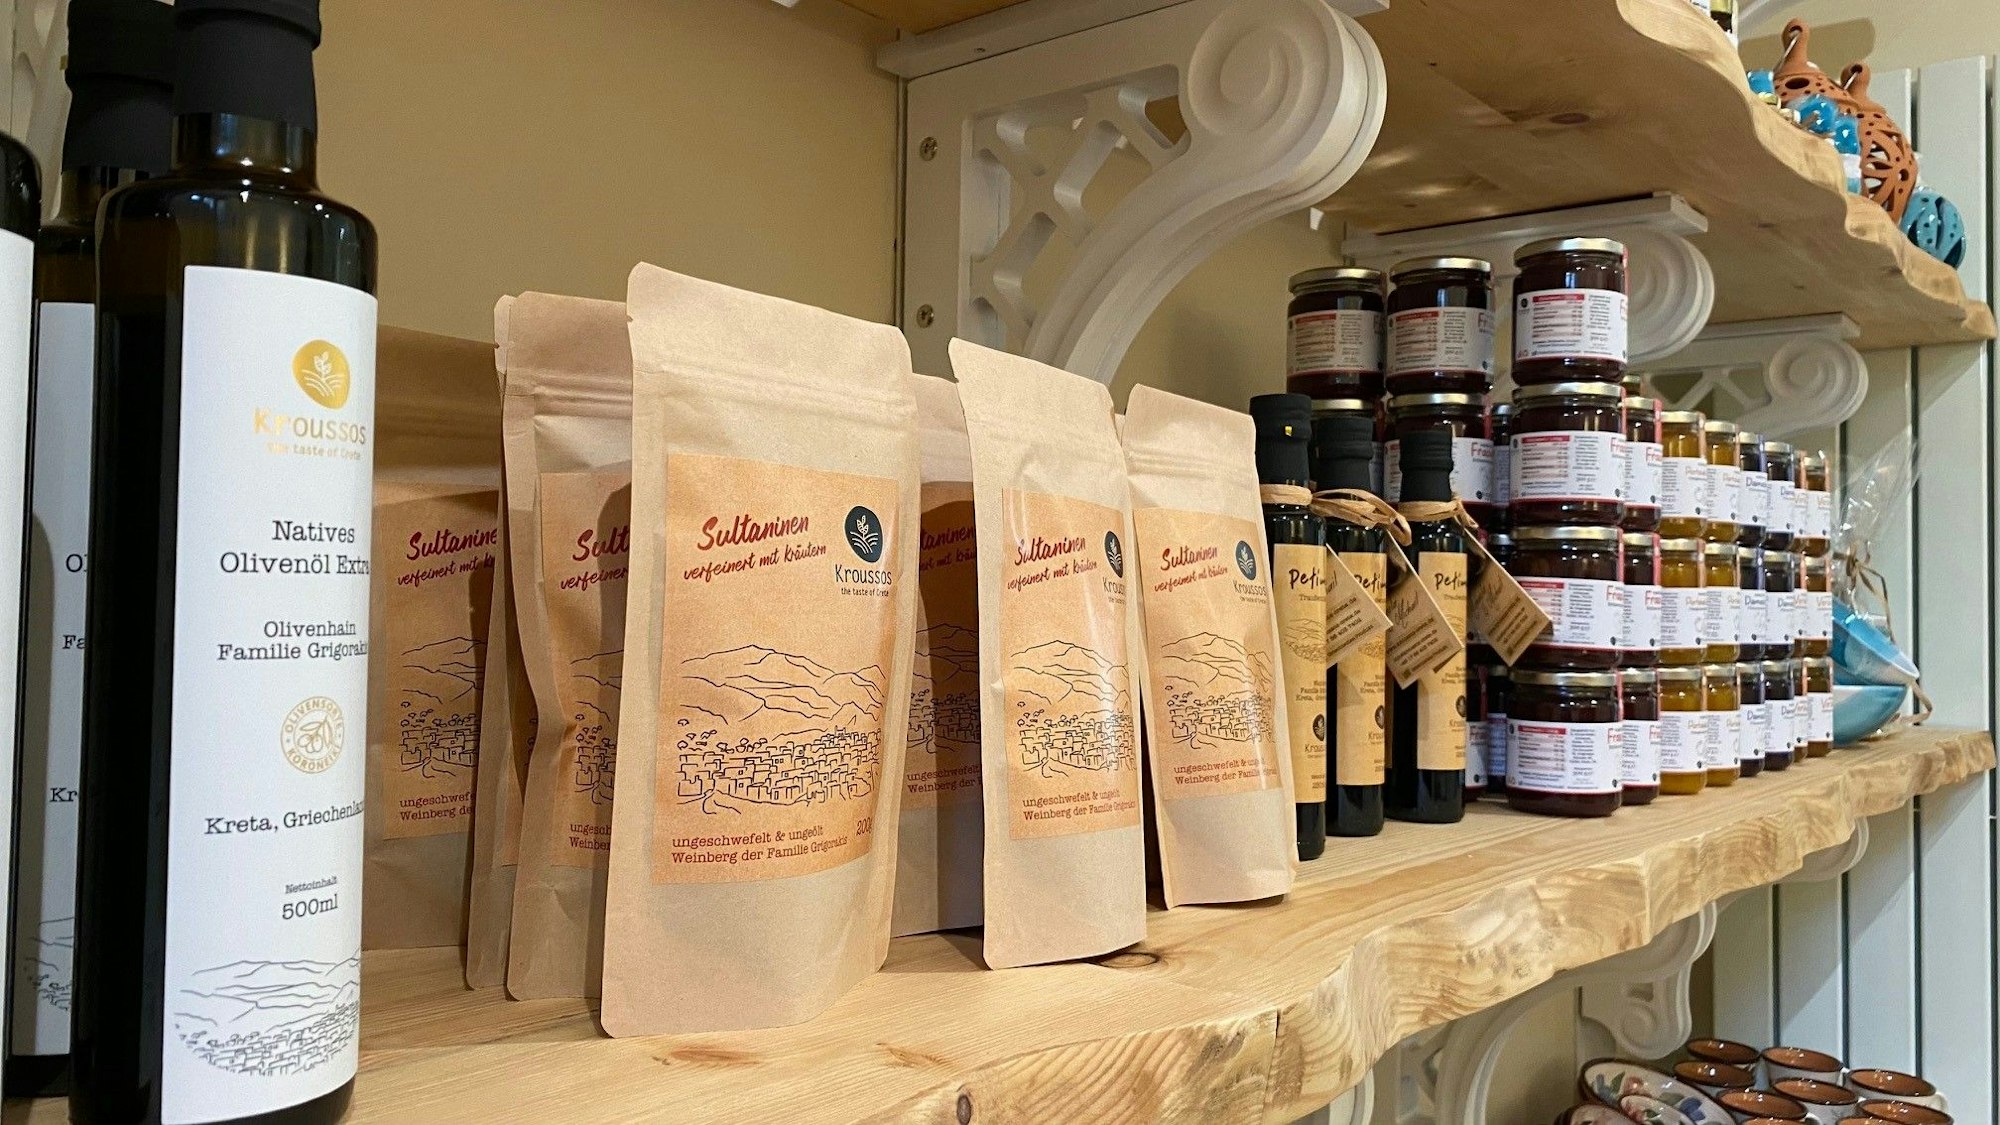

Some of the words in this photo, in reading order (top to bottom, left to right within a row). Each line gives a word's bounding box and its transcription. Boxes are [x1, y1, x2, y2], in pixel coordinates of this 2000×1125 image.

[254, 408, 366, 445] Kroussos
[272, 520, 355, 543] Natives
[697, 514, 809, 551] Sultaninen
[1014, 536, 1086, 566] Sultaninen
[1160, 545, 1218, 571] Sultaninen
[66, 554, 88, 573] O
[220, 552, 331, 575] Olivenöl
[398, 561, 456, 587] verfeinert
[459, 556, 478, 573] mit
[684, 552, 756, 582] verfeinert
[759, 547, 780, 567] mit
[835, 564, 893, 585] Kroussos
[1007, 567, 1051, 592] verfeinert
[1154, 571, 1197, 593] verfeinert
[841, 588, 851, 596] the
[852, 587, 868, 597] taste
[1233, 579, 1268, 597] Kroussos
[264, 620, 357, 638] Olivenhain
[217, 642, 301, 661] Familie
[1173, 759, 1240, 774] ungeschwefelt
[1174, 773, 1220, 786] Weinberg
[1221, 771, 1237, 781] der
[1022, 791, 1091, 808] ungeschwefelt
[400, 808, 456, 821] Weinberg
[1023, 808, 1072, 820] Weinberg
[1073, 805, 1088, 816] der
[204, 815, 278, 835] Kreta,
[672, 831, 772, 849] ungeschwefelt
[775, 830, 786, 842] &
[671, 851, 738, 864] Weinberg
[741, 849, 764, 862] der
[767, 843, 809, 859] Familie
[282, 893, 339, 920] 500ml
